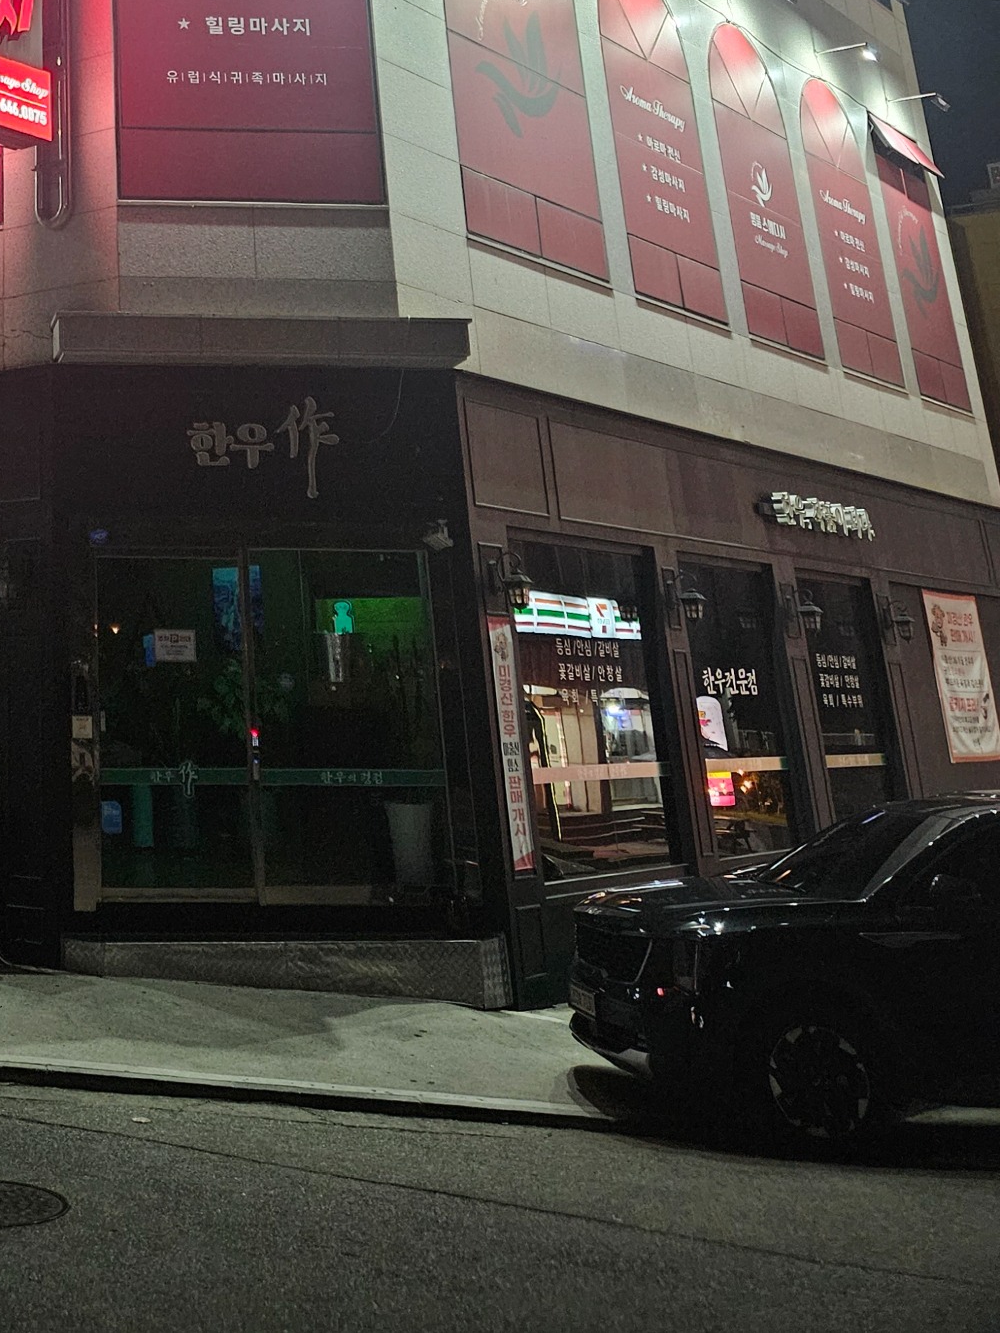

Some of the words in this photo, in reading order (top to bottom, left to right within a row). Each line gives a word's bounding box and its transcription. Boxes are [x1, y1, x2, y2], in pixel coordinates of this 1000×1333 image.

[205, 15, 312, 36] 힐링마사지
[20, 77, 49, 100] Shop
[619, 85, 653, 114] Aroma
[652, 98, 686, 133] Therapy
[645, 135, 667, 157] 아로마
[667, 143, 682, 164] 전신
[650, 165, 686, 194] 감성마사지
[655, 195, 691, 224] 힐링마사지
[750, 211, 762, 230] 명품
[818, 188, 844, 213] Aroma
[843, 199, 867, 227] Therapy
[497, 664, 514, 705] 미경산
[702, 667, 758, 696] 한우전문점
[500, 710, 517, 738] 한우
